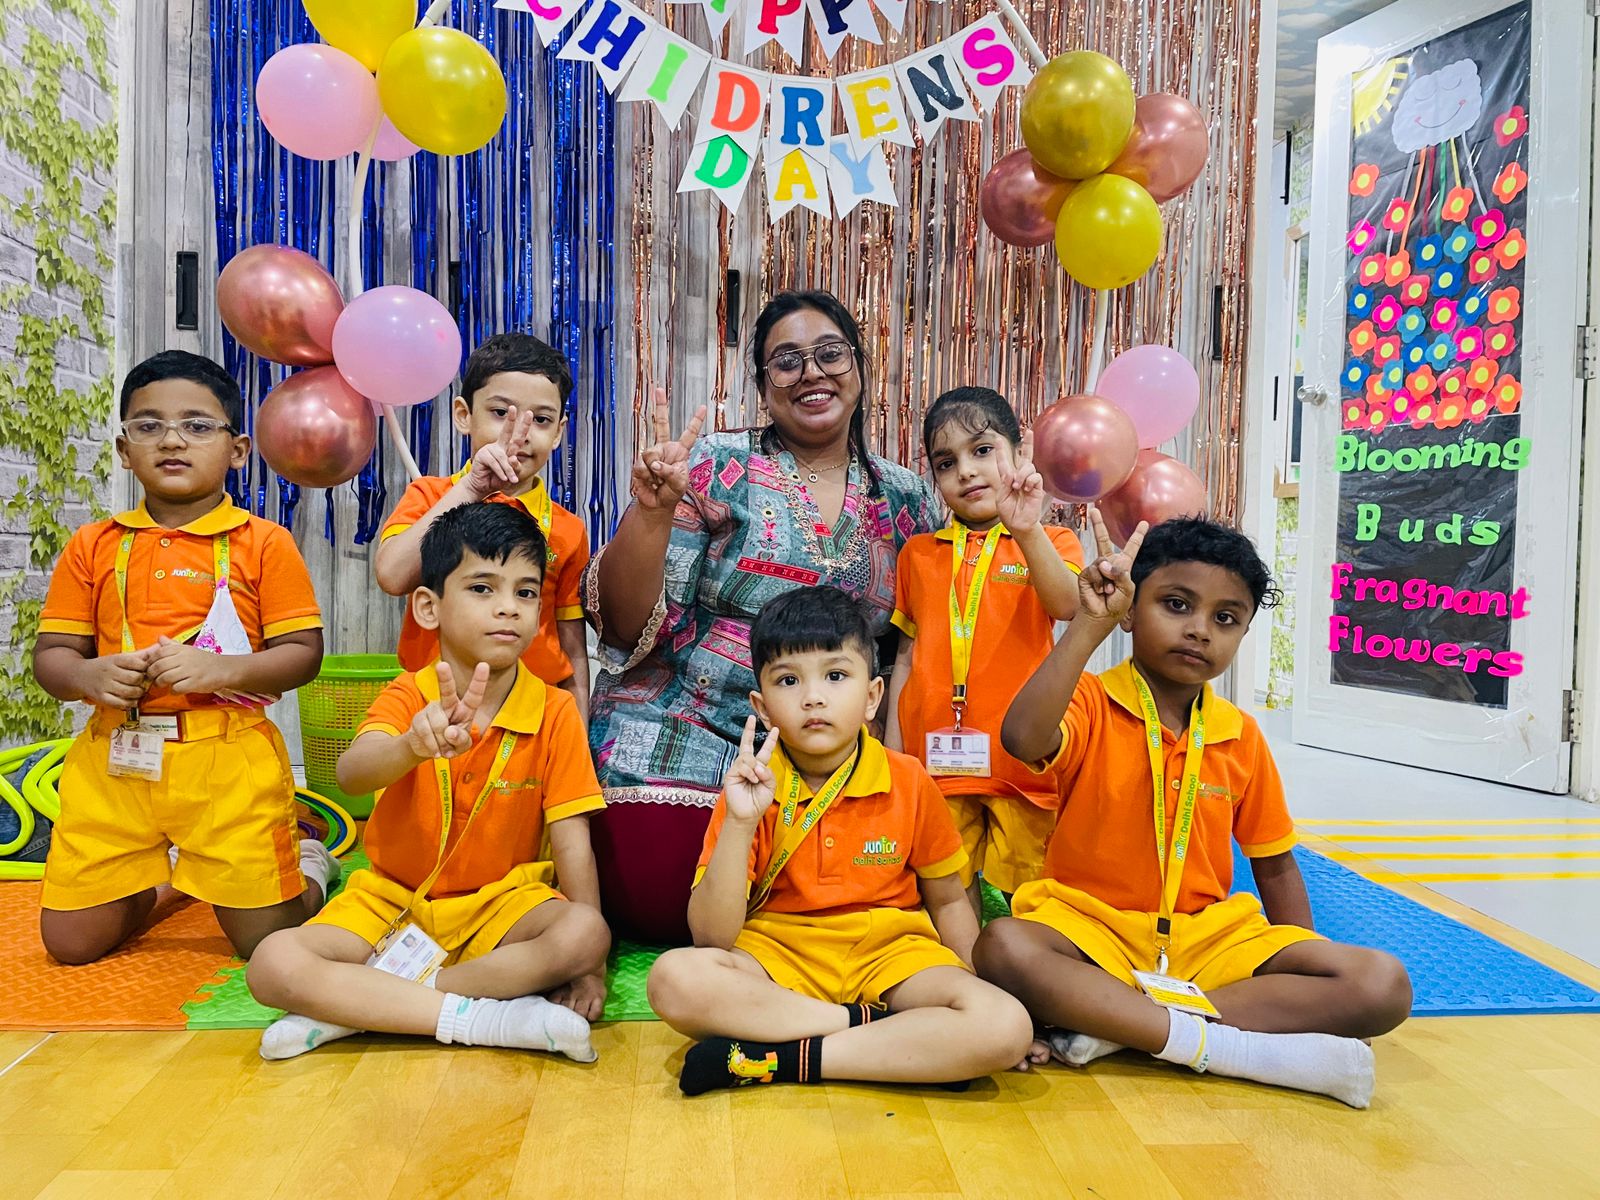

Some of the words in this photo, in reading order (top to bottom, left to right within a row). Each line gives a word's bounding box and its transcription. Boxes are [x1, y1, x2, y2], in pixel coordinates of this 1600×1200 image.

[694, 136, 875, 202] DAY
[1334, 434, 1532, 472] Blooming
[1355, 503, 1501, 545] Buds
[1330, 563, 1532, 619] Fragnant
[1328, 615, 1525, 677] Flowers
[818, 786, 836, 809] Delhi
[833, 763, 853, 790] School
[1185, 773, 1198, 807] School
[1180, 807, 1192, 833] Delhi
